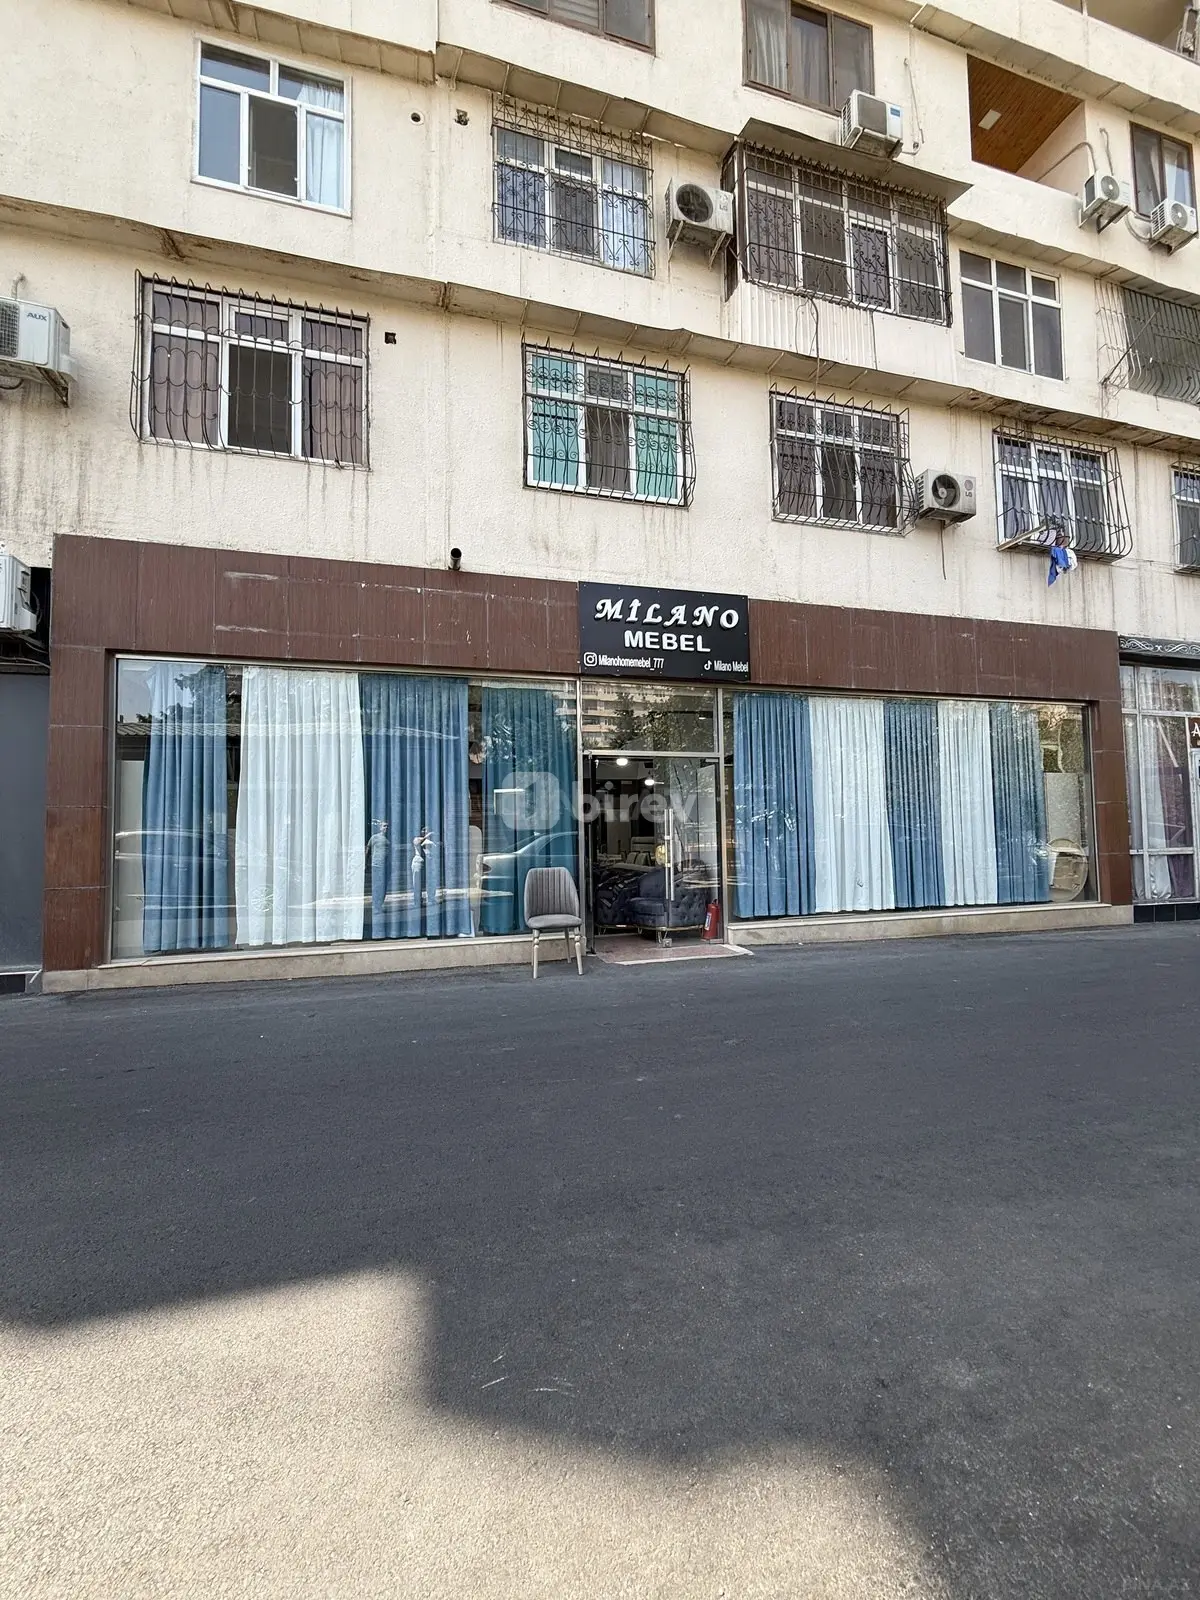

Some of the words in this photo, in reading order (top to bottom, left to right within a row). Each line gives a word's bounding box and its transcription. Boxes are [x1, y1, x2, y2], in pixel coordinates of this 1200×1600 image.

[26, 312, 48, 322] AUX
[624, 630, 711, 653] MEBEL
[598, 654, 665, 671] Milanohomemebel_777
[713, 660, 732, 672] Milano
[732, 661, 749, 672] Mebel
